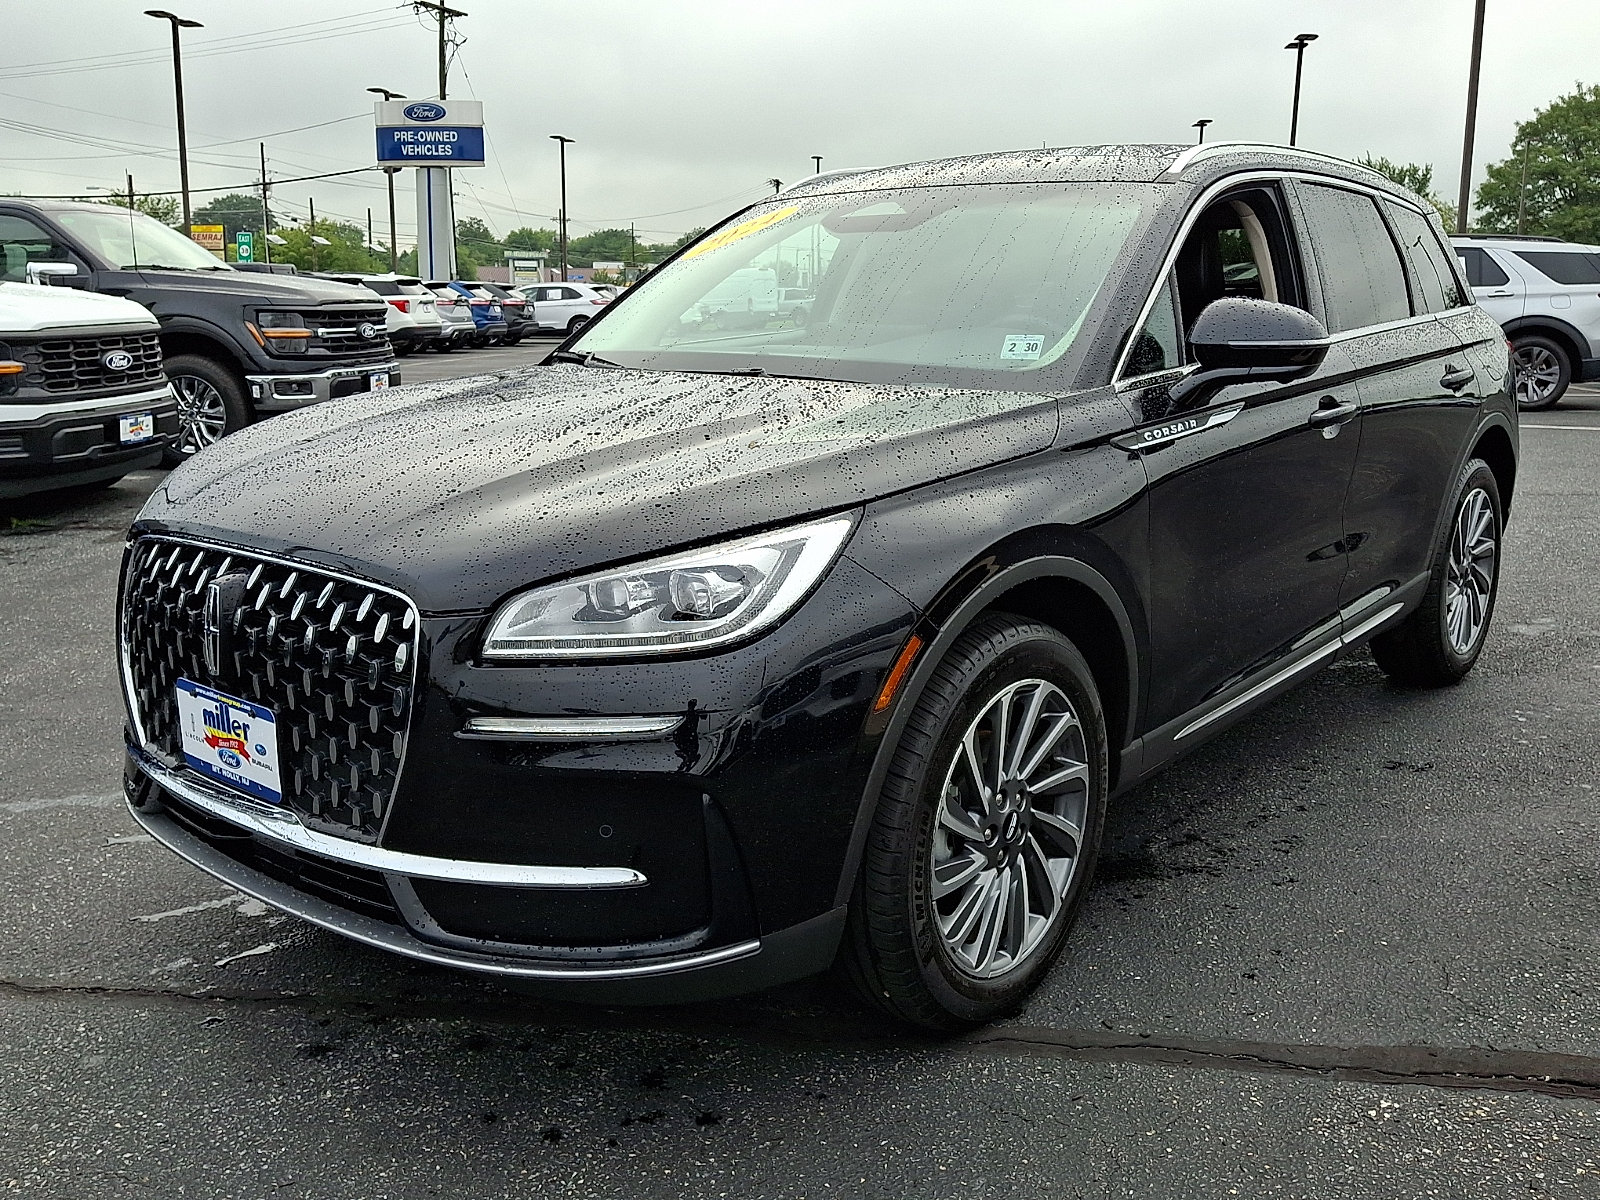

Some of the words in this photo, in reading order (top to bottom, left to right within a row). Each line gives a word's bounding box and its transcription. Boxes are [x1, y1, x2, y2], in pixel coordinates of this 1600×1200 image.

[411, 106, 436, 118] Ford
[393, 131, 458, 142] PRE-OWNED
[401, 144, 453, 156] VEHICLES
[191, 233, 222, 241] SEMRAJ
[1008, 342, 1017, 352] 2
[1024, 342, 1038, 352] 30
[112, 356, 128, 367] Ford
[1143, 420, 1197, 440] CORSAIR
[202, 702, 250, 743] miller
[221, 751, 237, 766] Ford
[211, 764, 221, 774] MT.
[222, 769, 240, 783] HOLLY,
[914, 810, 929, 921] MICHELIN
